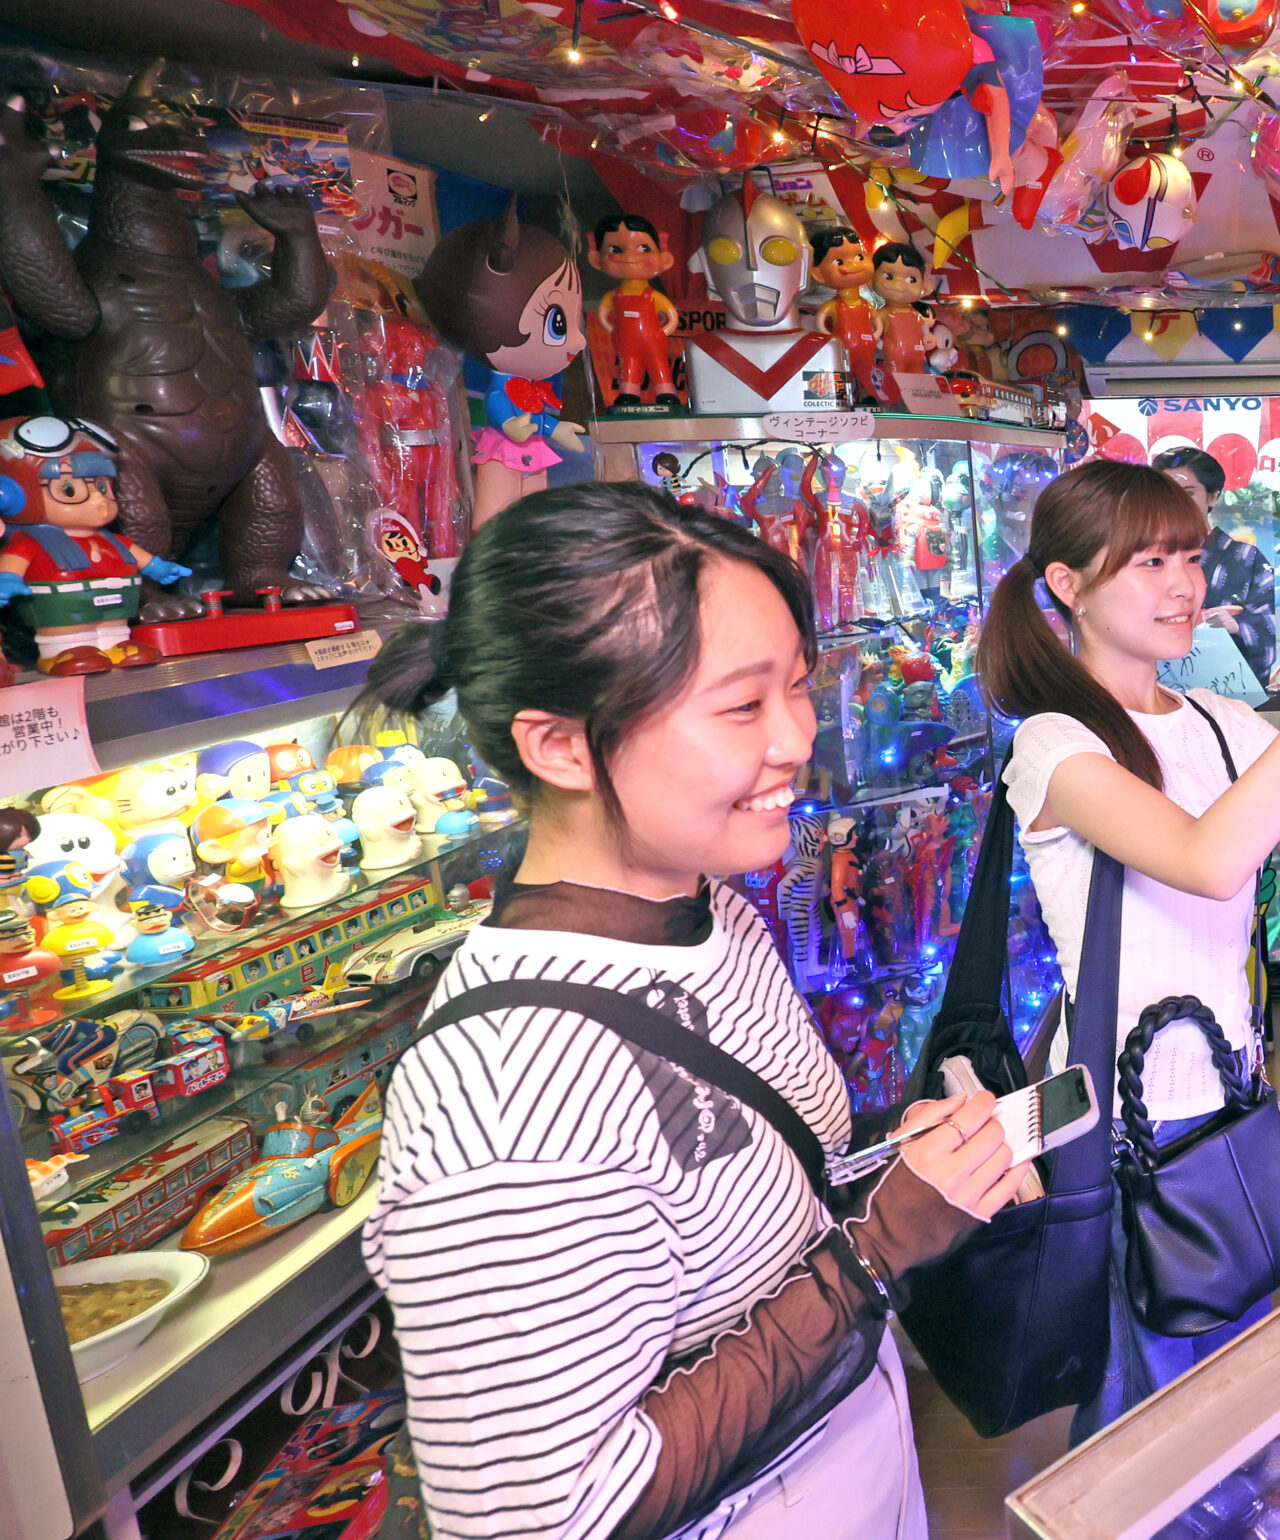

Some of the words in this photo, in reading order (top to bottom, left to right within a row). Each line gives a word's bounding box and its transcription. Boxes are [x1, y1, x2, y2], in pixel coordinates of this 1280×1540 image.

[317, 132, 345, 142] MODEL
[1163, 397, 1262, 412] SANYO
[769, 414, 869, 428] ヴィンテージソフビ
[794, 429, 839, 439] コーナー
[12, 718, 62, 739] 営業中!
[0, 731, 70, 756] がり下さい
